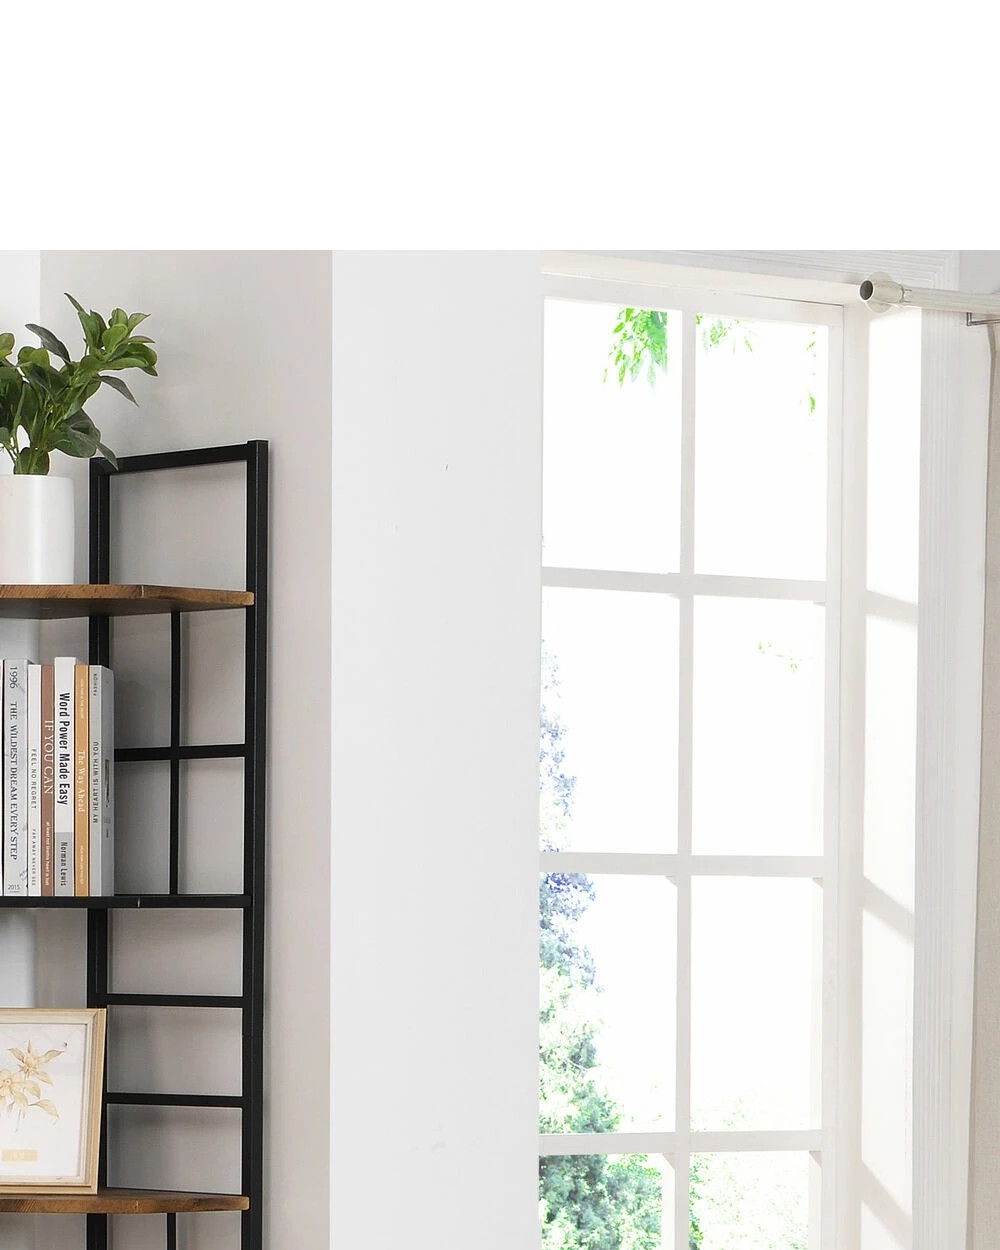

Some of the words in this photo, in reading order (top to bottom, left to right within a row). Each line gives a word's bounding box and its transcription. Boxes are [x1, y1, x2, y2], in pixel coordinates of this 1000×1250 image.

[9, 666, 18, 689] 1996
[59, 693, 70, 717] Word
[44, 720, 54, 731] IF
[59, 720, 70, 749] Power
[10, 725, 18, 766] WILDEST
[44, 735, 54, 762] YOU
[31, 769, 37, 779] NO
[59, 753, 70, 779] Made
[76, 767, 85, 785] Way
[10, 767, 18, 801] DREAM
[43, 766, 53, 794] CAN
[57, 783, 70, 805] Easy
[10, 803, 19, 834] EVERY
[93, 814, 98, 823] MY
[60, 842, 68, 867] Norman
[60, 868, 68, 886] Lewis
